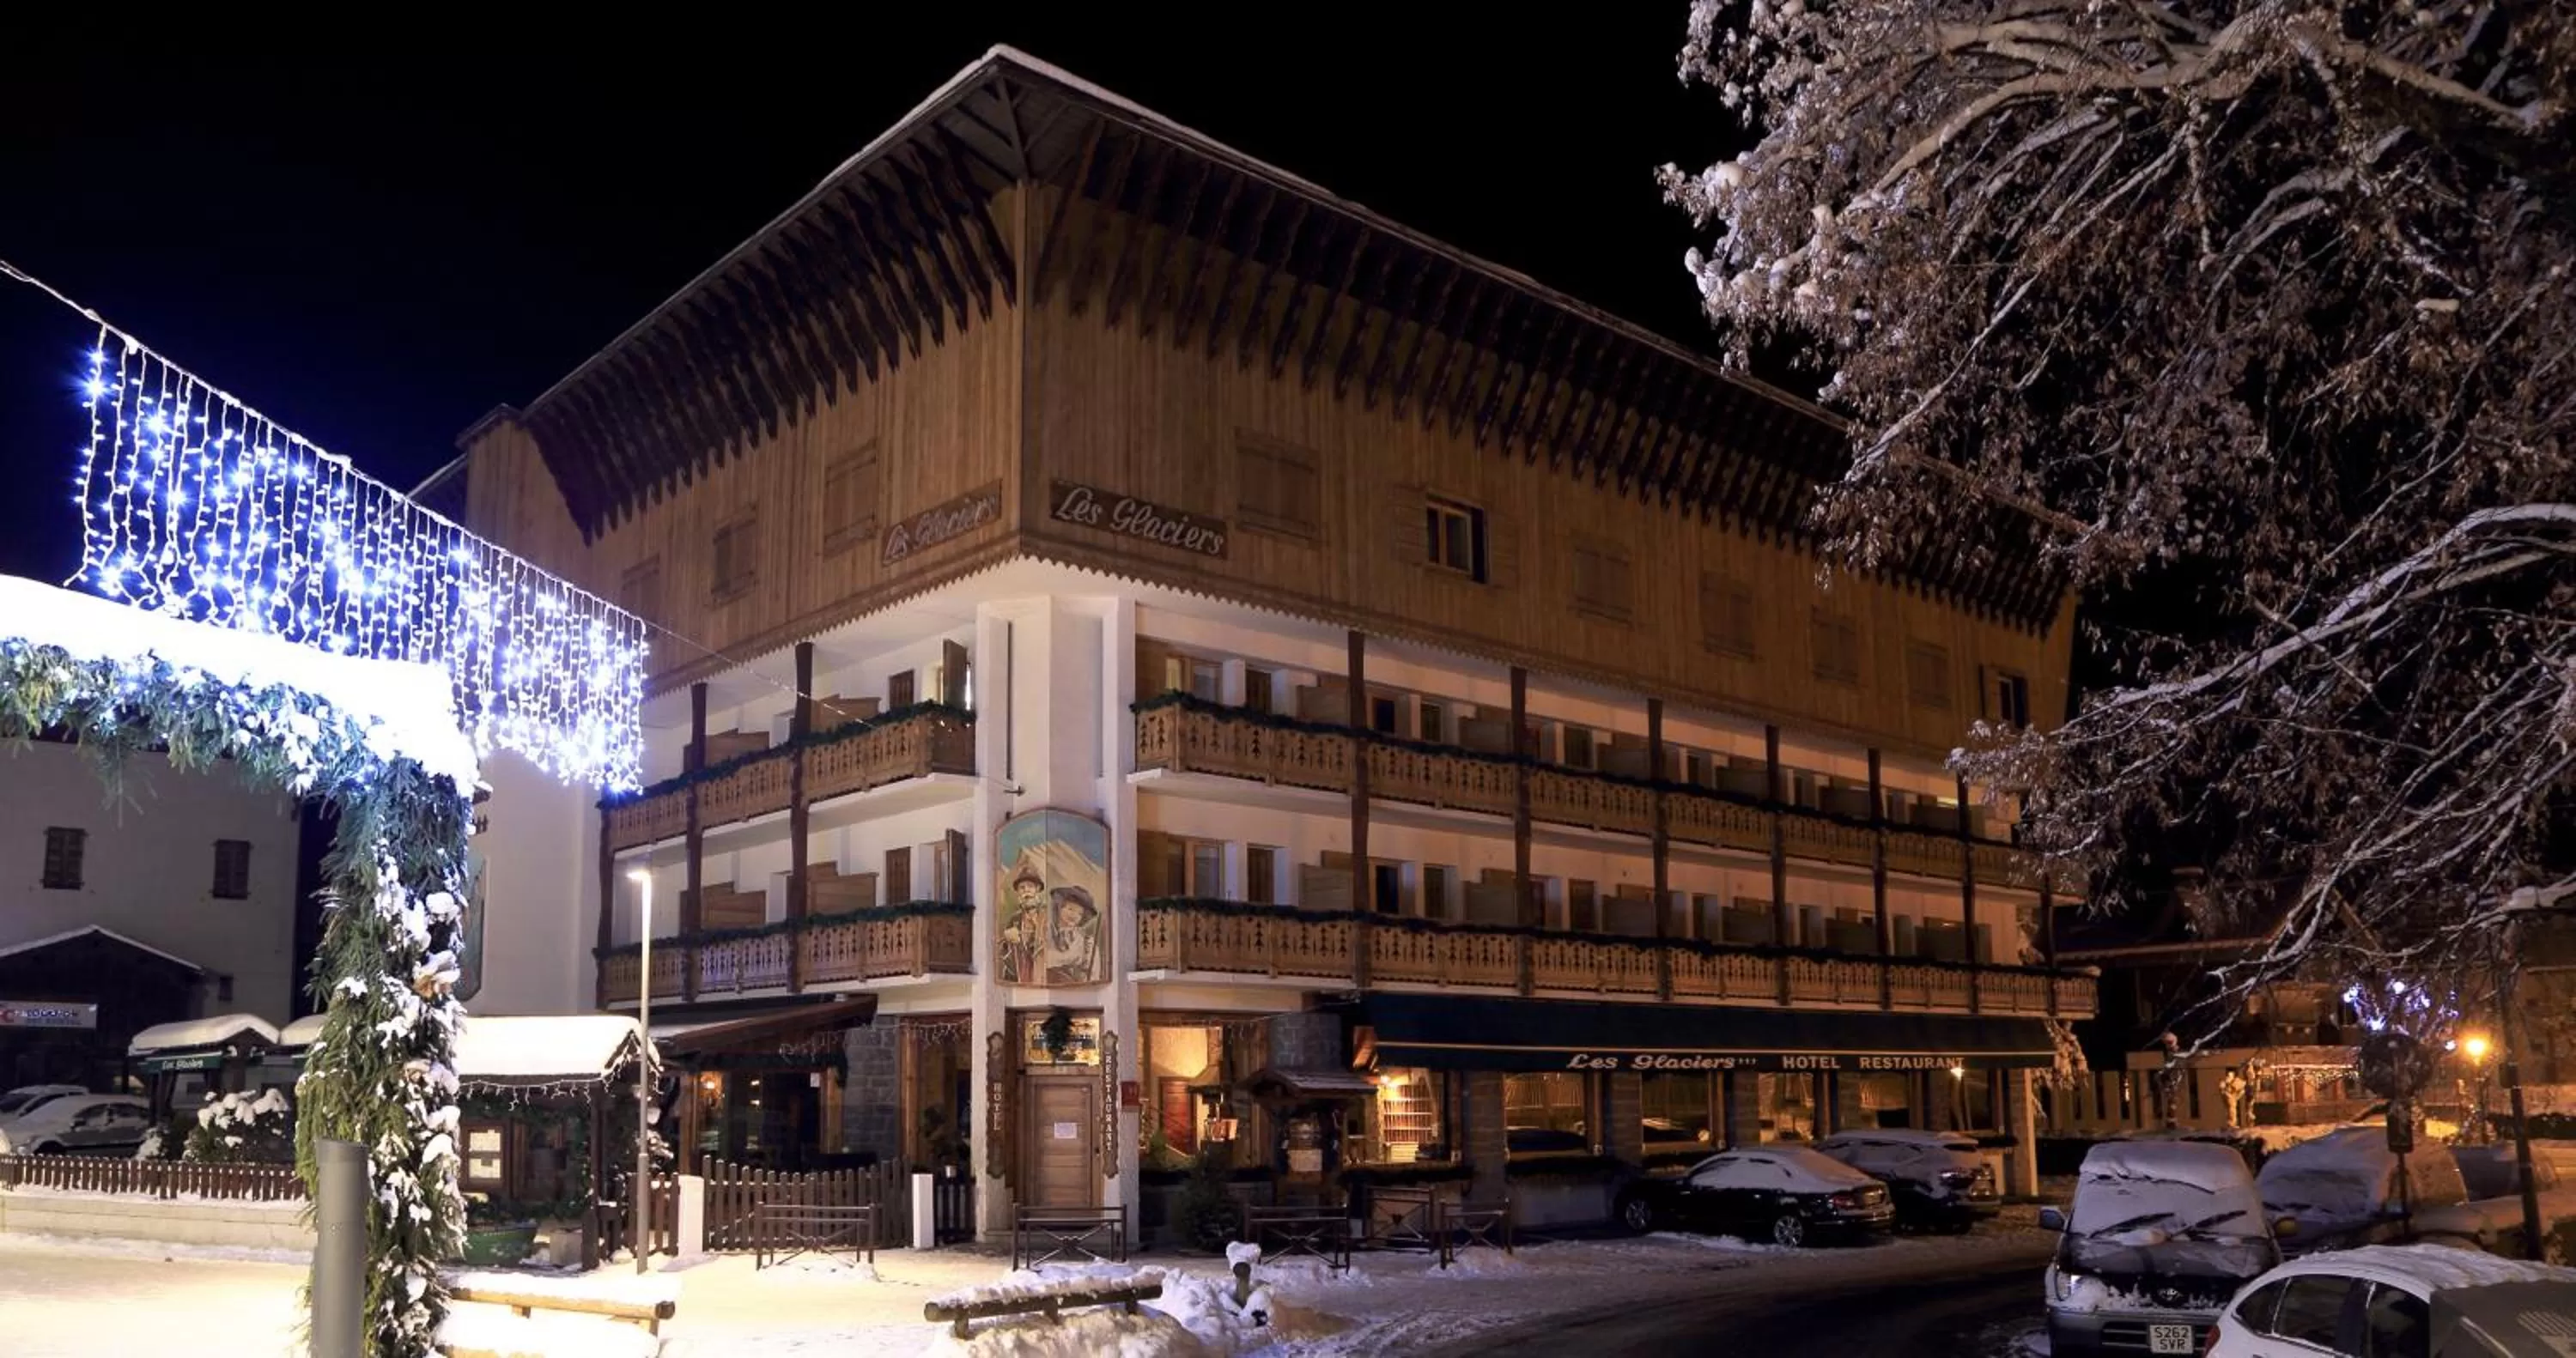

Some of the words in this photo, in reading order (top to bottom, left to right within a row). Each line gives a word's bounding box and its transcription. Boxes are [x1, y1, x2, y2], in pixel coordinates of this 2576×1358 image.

[1056, 487, 1103, 524] Les
[1109, 497, 1224, 554] Glaciers
[1566, 1053, 1619, 1070] Les
[1631, 1053, 1735, 1070] Glaciers
[1782, 1055, 1841, 1070] HOTEL
[1858, 1056, 1965, 1070] RESTAURANT
[993, 1082, 1002, 1131] HOTEL
[1104, 1054, 1114, 1151] RESTAURANT
[2154, 1326, 2189, 1338] S262
[2160, 1338, 2185, 1350] SVR
